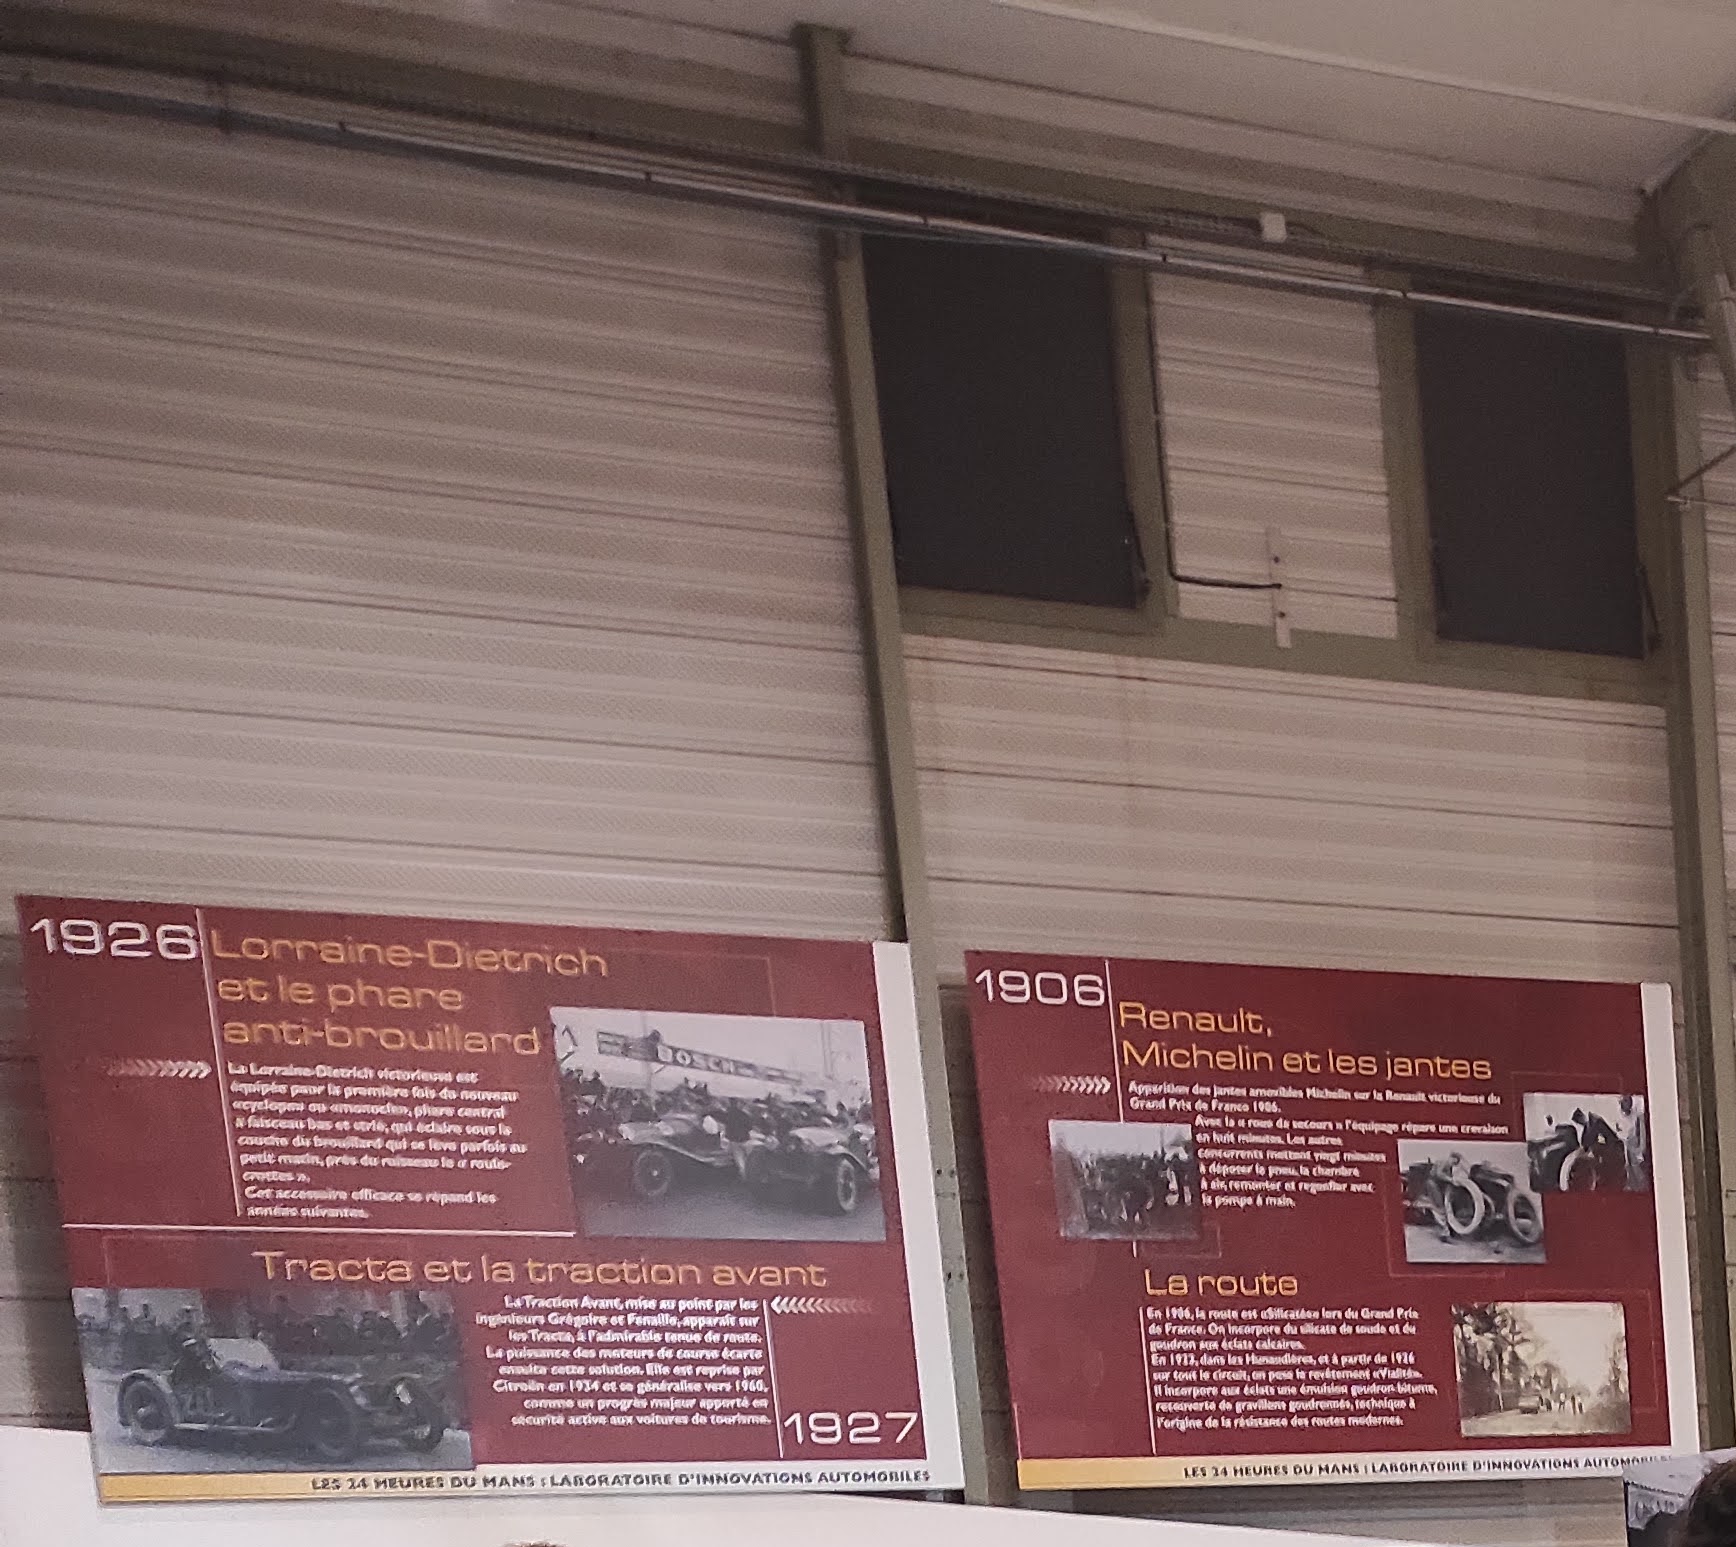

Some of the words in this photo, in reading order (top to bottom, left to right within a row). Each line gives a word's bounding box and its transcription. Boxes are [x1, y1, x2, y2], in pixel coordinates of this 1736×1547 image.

[30, 918, 198, 960] 1926
[214, 930, 608, 978] Lorraine-Dietrich
[218, 976, 267, 1003] et
[279, 976, 314, 1005] le
[330, 978, 462, 1014] phare
[974, 970, 1106, 1007] 1906
[224, 1017, 540, 1056] anti-brouillard
[1119, 1001, 1273, 1037] Renault,
[1123, 1040, 1273, 1075] Michelin
[1282, 1048, 1320, 1075] et
[1329, 1048, 1375, 1077] les
[1384, 1052, 1492, 1081] jantes
[252, 1249, 413, 1284] Tracta
[425, 1254, 470, 1284] et
[482, 1252, 519, 1284] la
[528, 1255, 701, 1287] traction
[713, 1260, 827, 1288] avant
[1144, 1268, 1188, 1296] La
[1198, 1272, 1298, 1296] route
[784, 1411, 918, 1445] 1927
